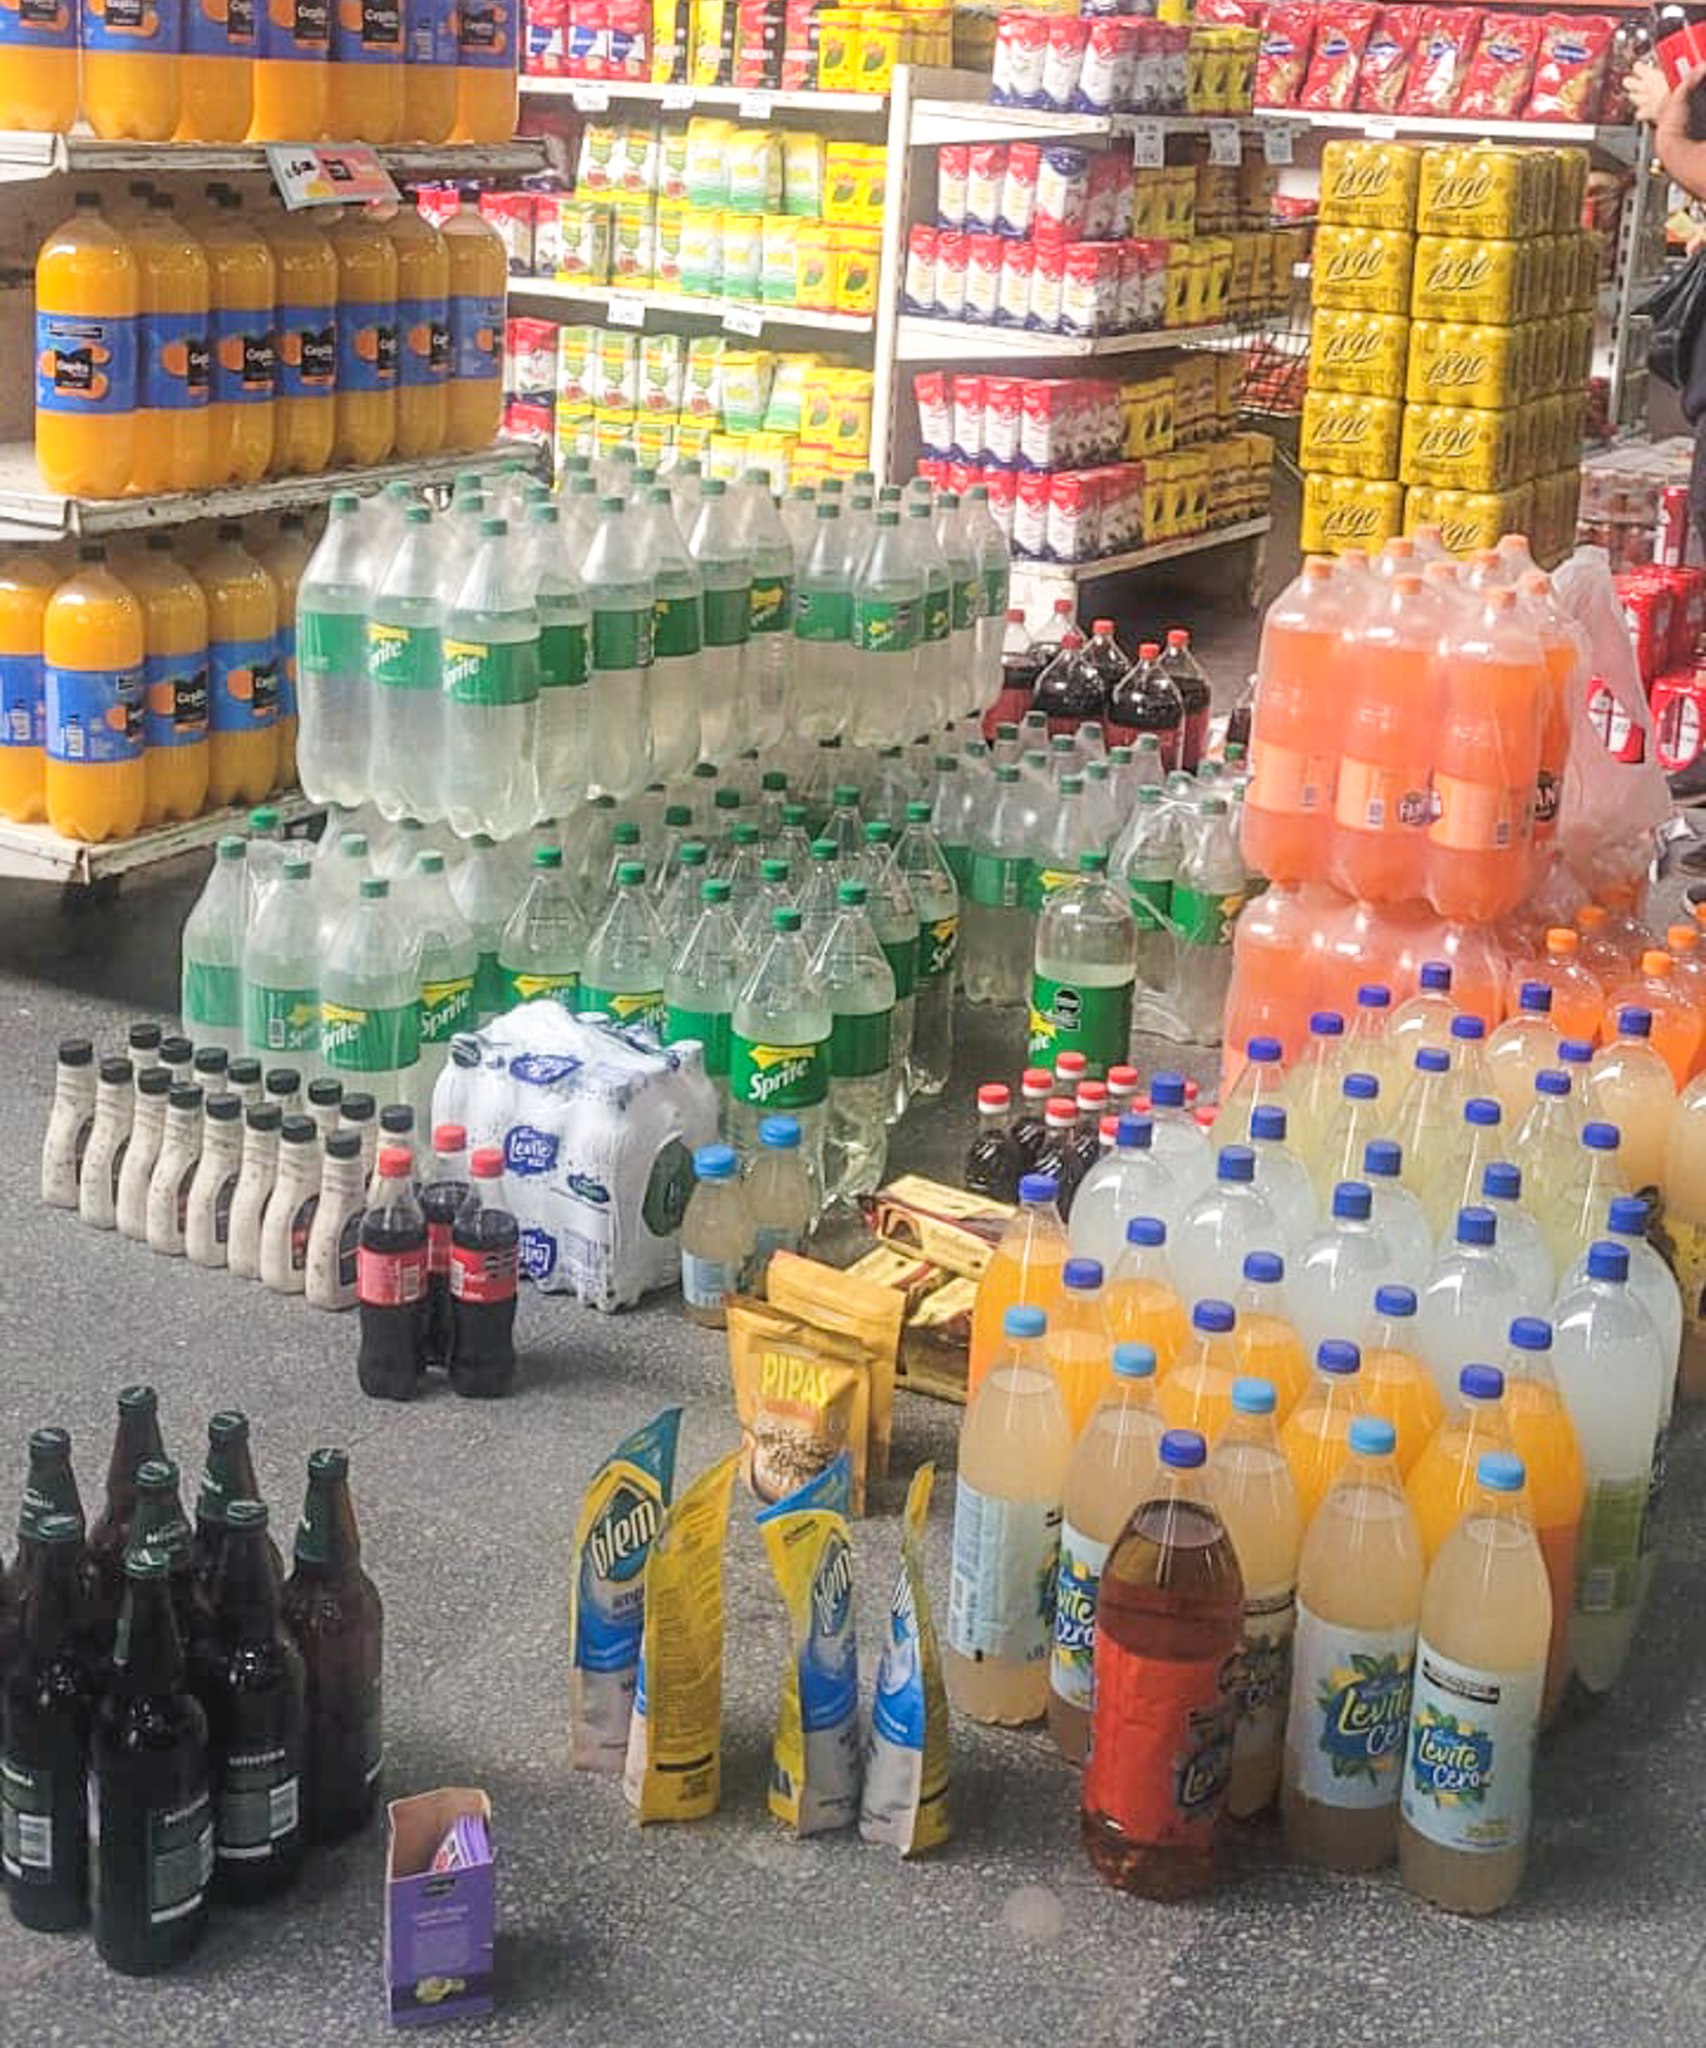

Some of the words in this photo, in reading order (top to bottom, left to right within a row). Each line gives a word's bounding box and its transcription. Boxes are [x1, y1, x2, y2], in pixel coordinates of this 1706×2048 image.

[1333, 163, 1389, 197] 1890
[1434, 174, 1496, 210] 1890
[1327, 249, 1385, 281] 1890
[1427, 254, 1496, 290] 1890
[1324, 331, 1381, 361] 1890
[1427, 350, 1487, 385] 1890
[1312, 415, 1369, 444] 1890
[1418, 426, 1478, 457] 1890
[1324, 504, 1381, 536] 1890
[419, 989, 471, 1038] Sprite
[747, 1059, 810, 1102] Sprite
[761, 1352, 832, 1410] PIPAS
[591, 1501, 656, 1578] blem
[1433, 1764, 1480, 1791] Cero
